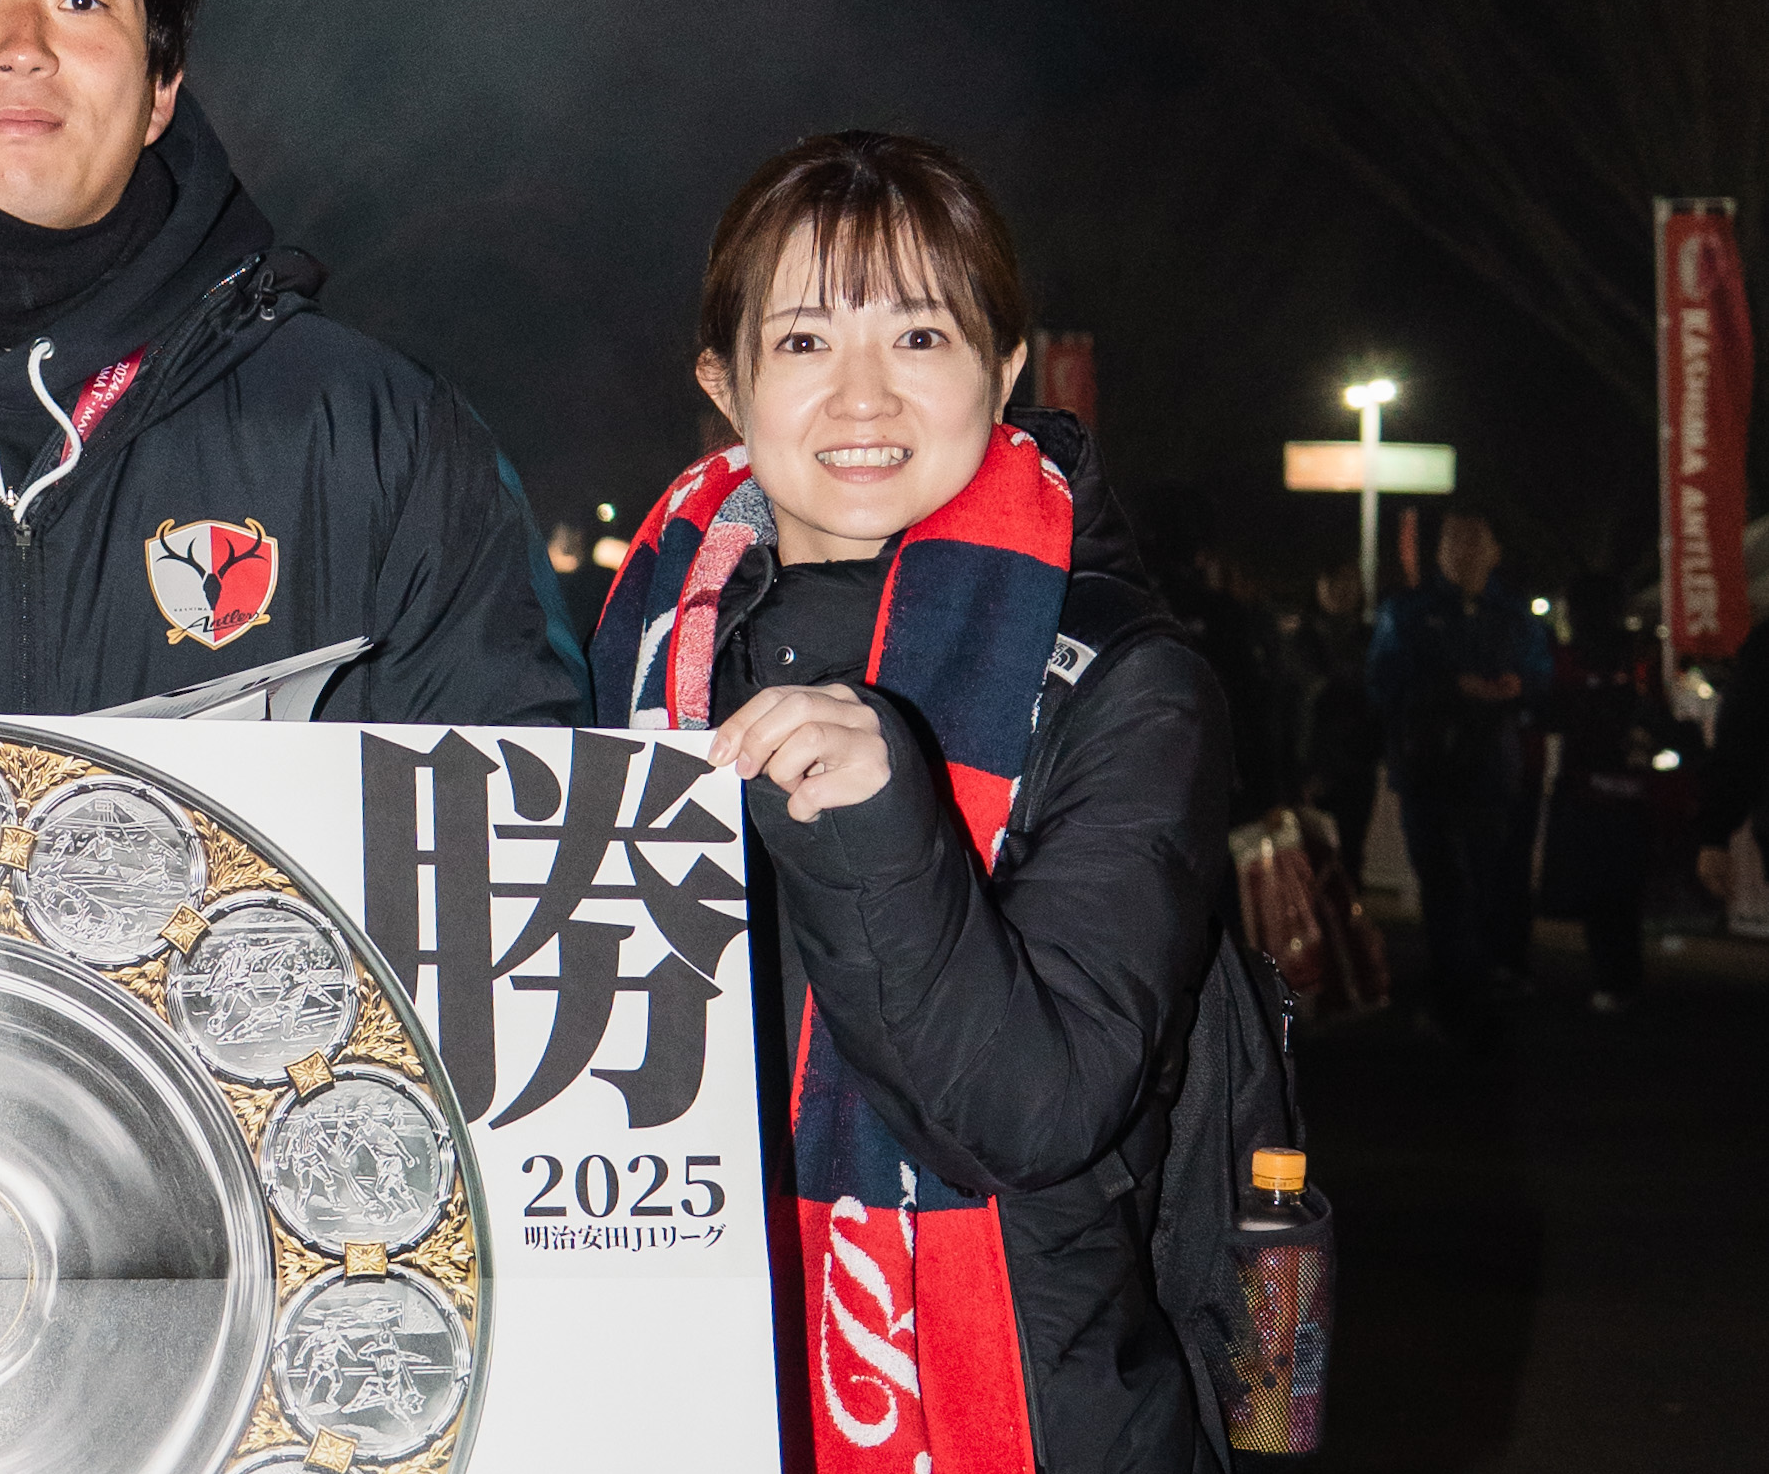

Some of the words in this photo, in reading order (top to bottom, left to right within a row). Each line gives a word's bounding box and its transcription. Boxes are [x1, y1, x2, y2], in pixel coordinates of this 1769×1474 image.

[361, 728, 748, 1131] 勝
[521, 1154, 725, 1218] 2025
[524, 1223, 727, 1252] 明治安田J1リーグ
